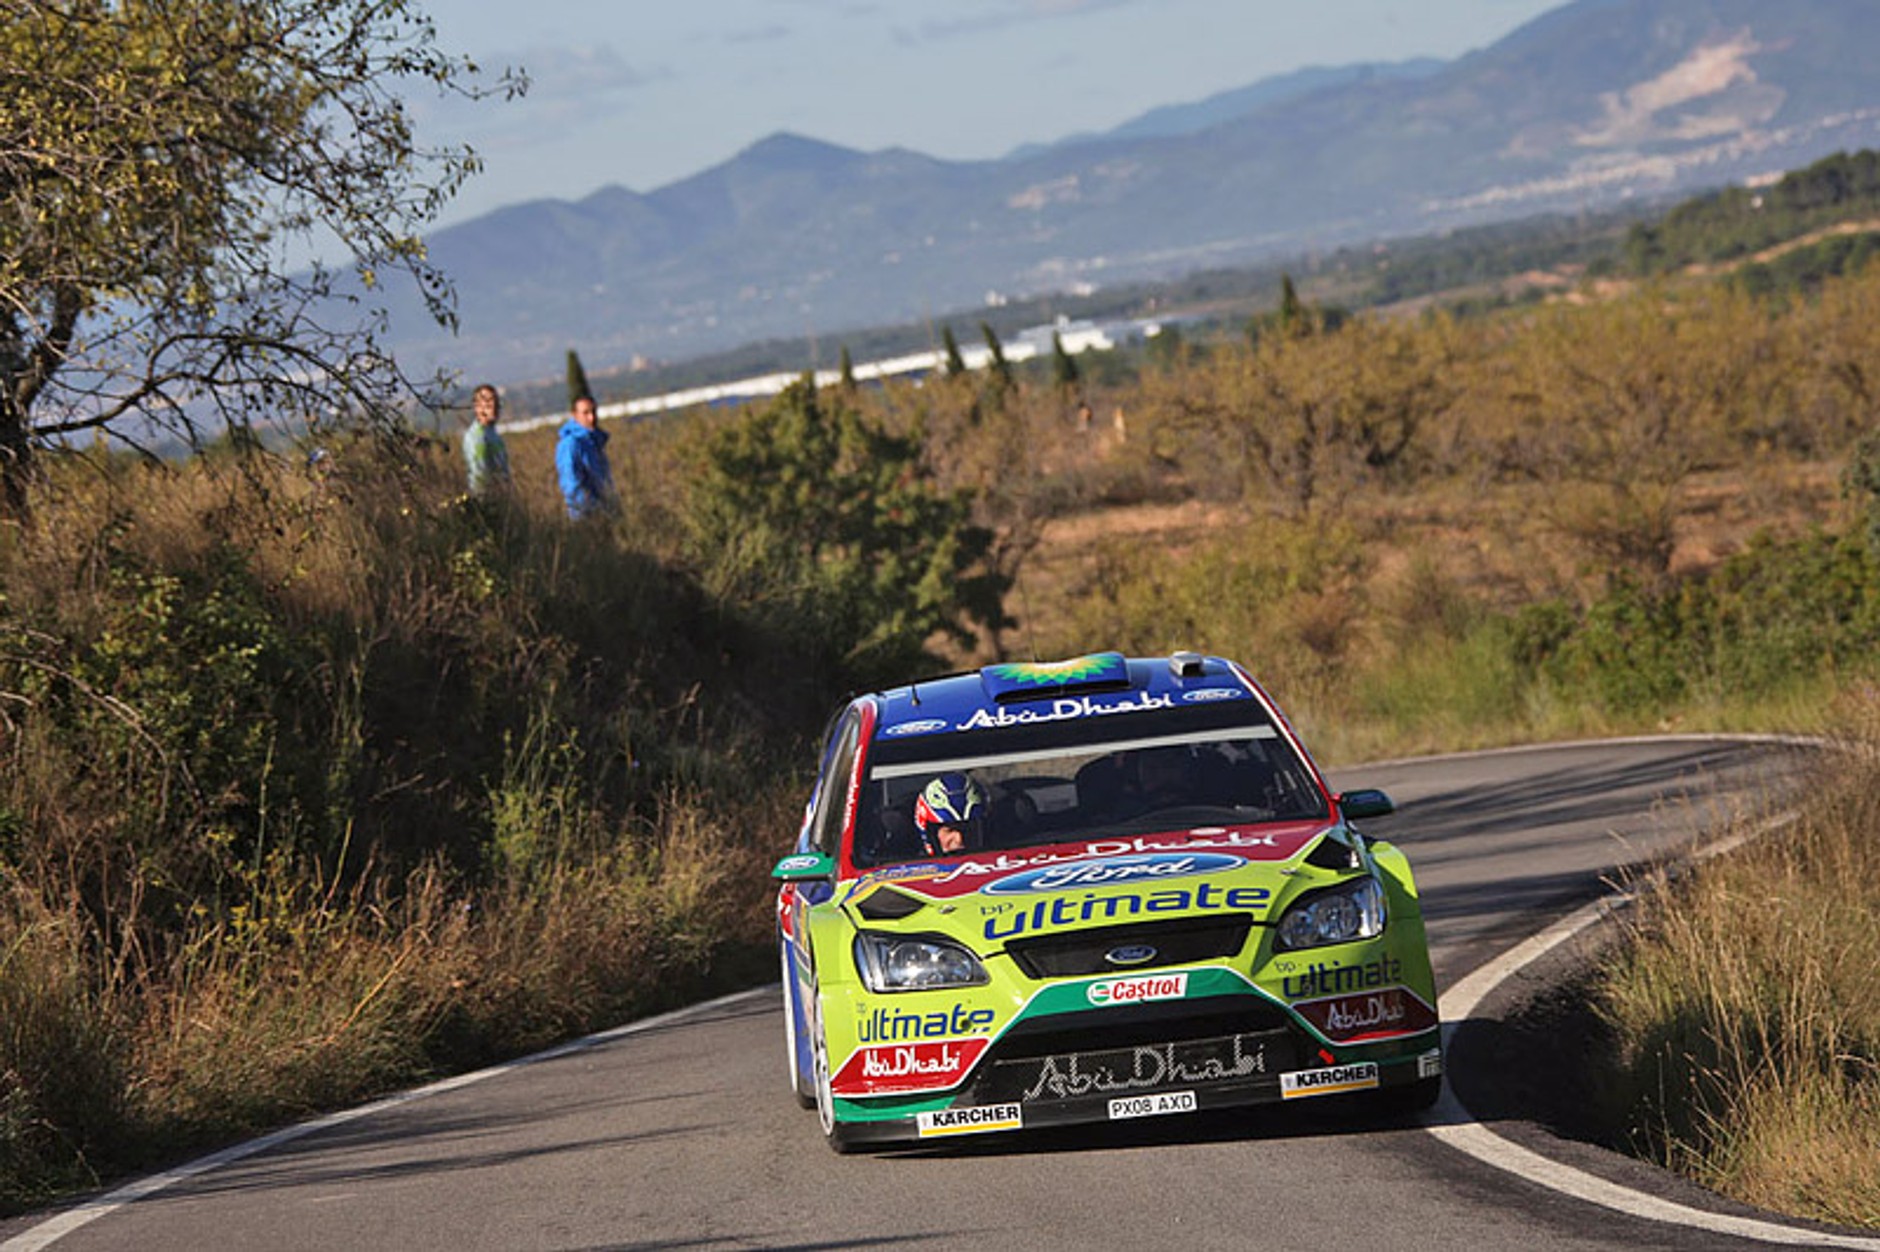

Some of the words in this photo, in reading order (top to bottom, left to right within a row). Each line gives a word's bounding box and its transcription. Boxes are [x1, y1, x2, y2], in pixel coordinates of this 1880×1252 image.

[1031, 857, 1196, 888] Ford
[984, 883, 1271, 940] ultimate
[1113, 977, 1181, 1001] Castrol
[858, 1003, 995, 1042] ultimate
[1112, 1101, 1153, 1116] PX08
[1158, 1097, 1193, 1111] AXD
